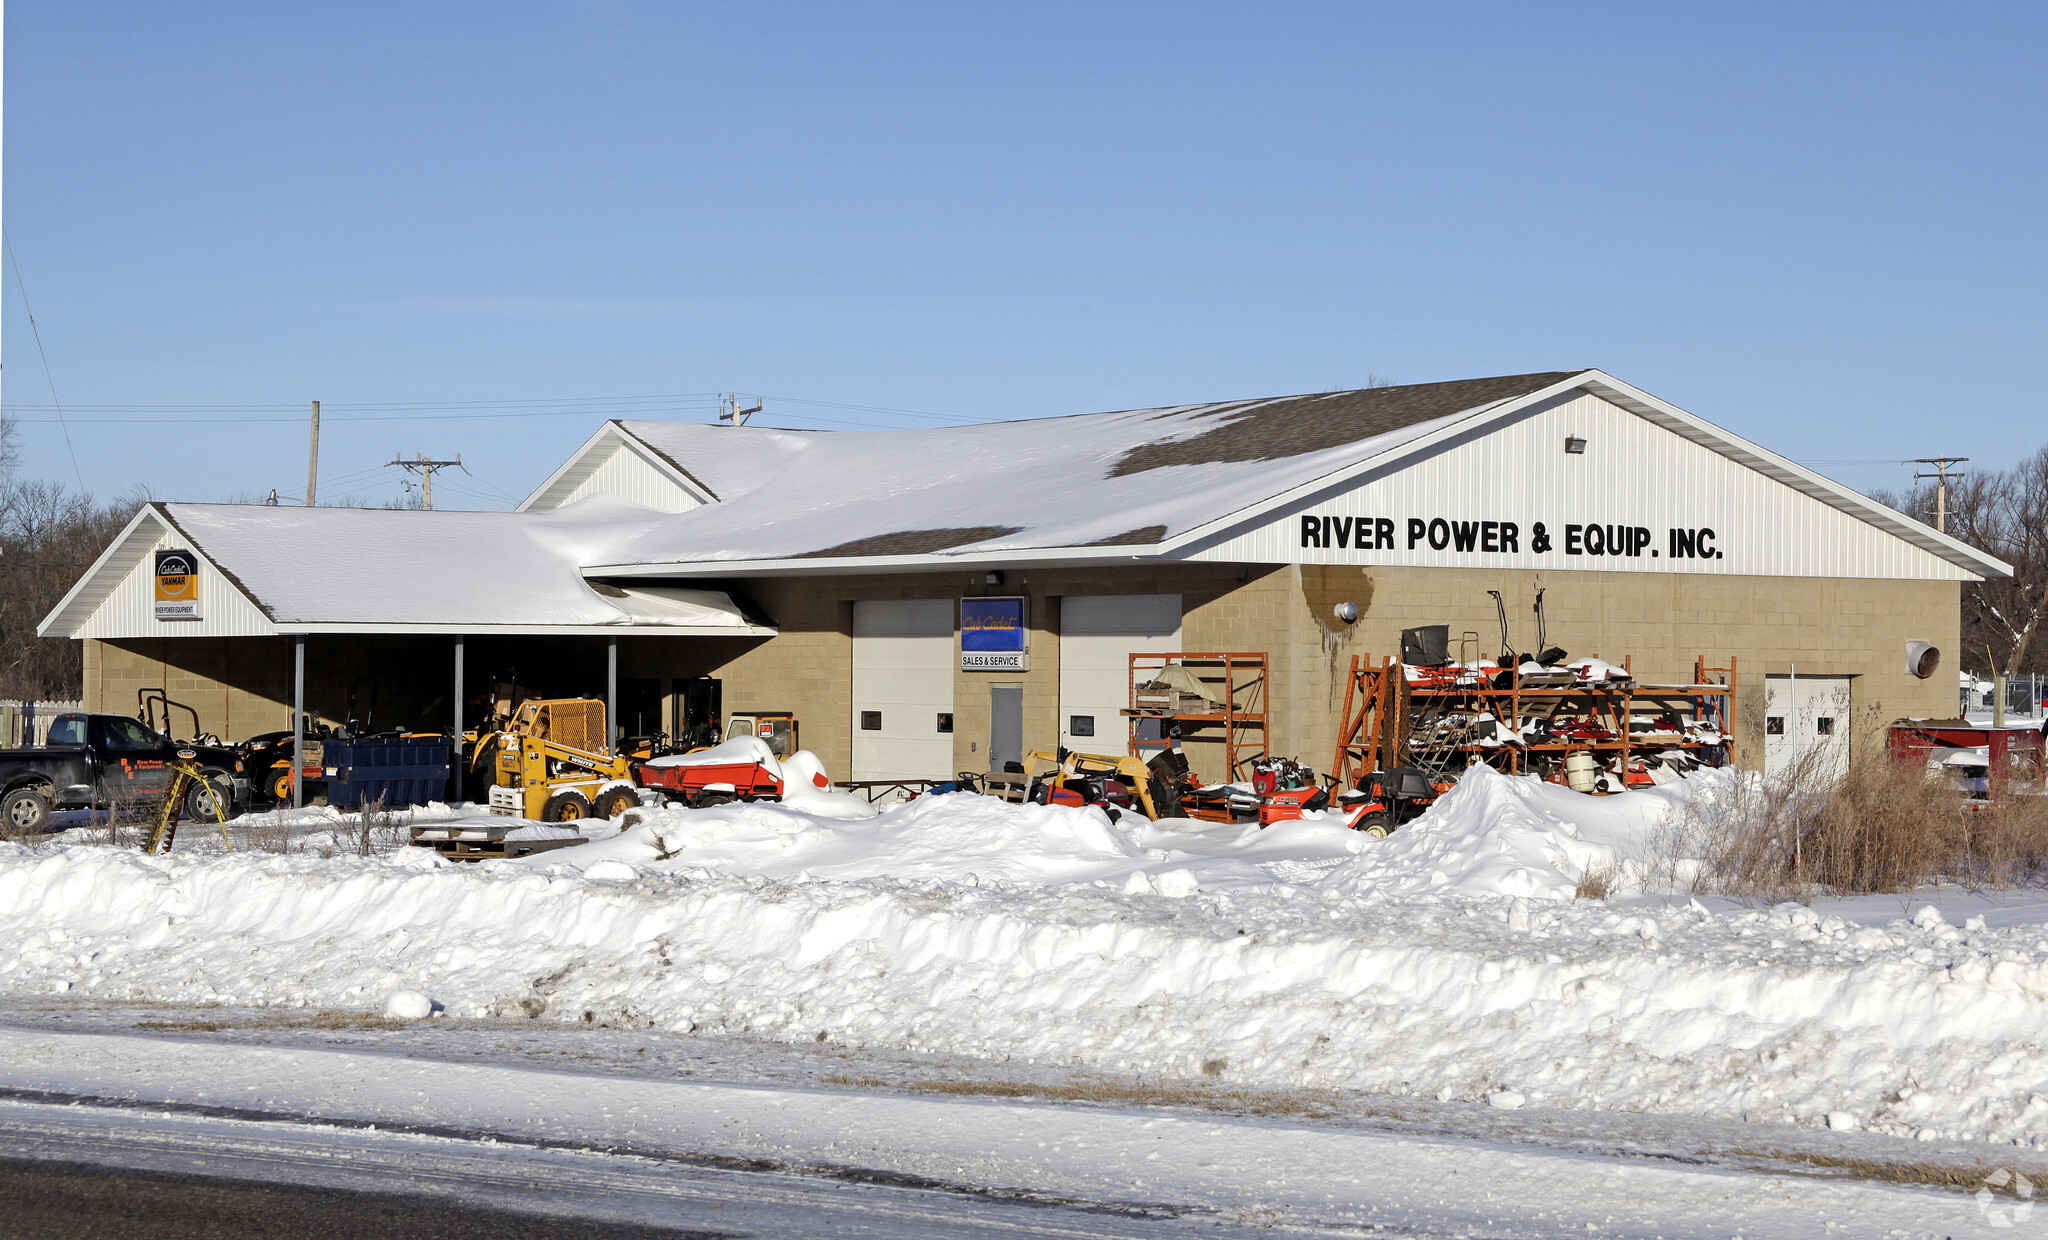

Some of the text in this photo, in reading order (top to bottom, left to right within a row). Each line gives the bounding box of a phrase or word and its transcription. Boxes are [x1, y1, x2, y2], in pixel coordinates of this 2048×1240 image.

[1301, 515, 1722, 559] RIVER POWER & EQUIP. INC.
[161, 565, 186, 575] Cub Cadet
[162, 576, 185, 585] YANMAR
[963, 616, 1018, 630] Cub Cadet
[962, 656, 1018, 666] SALES & SERVICE
[571, 756, 594, 768] WHITE
